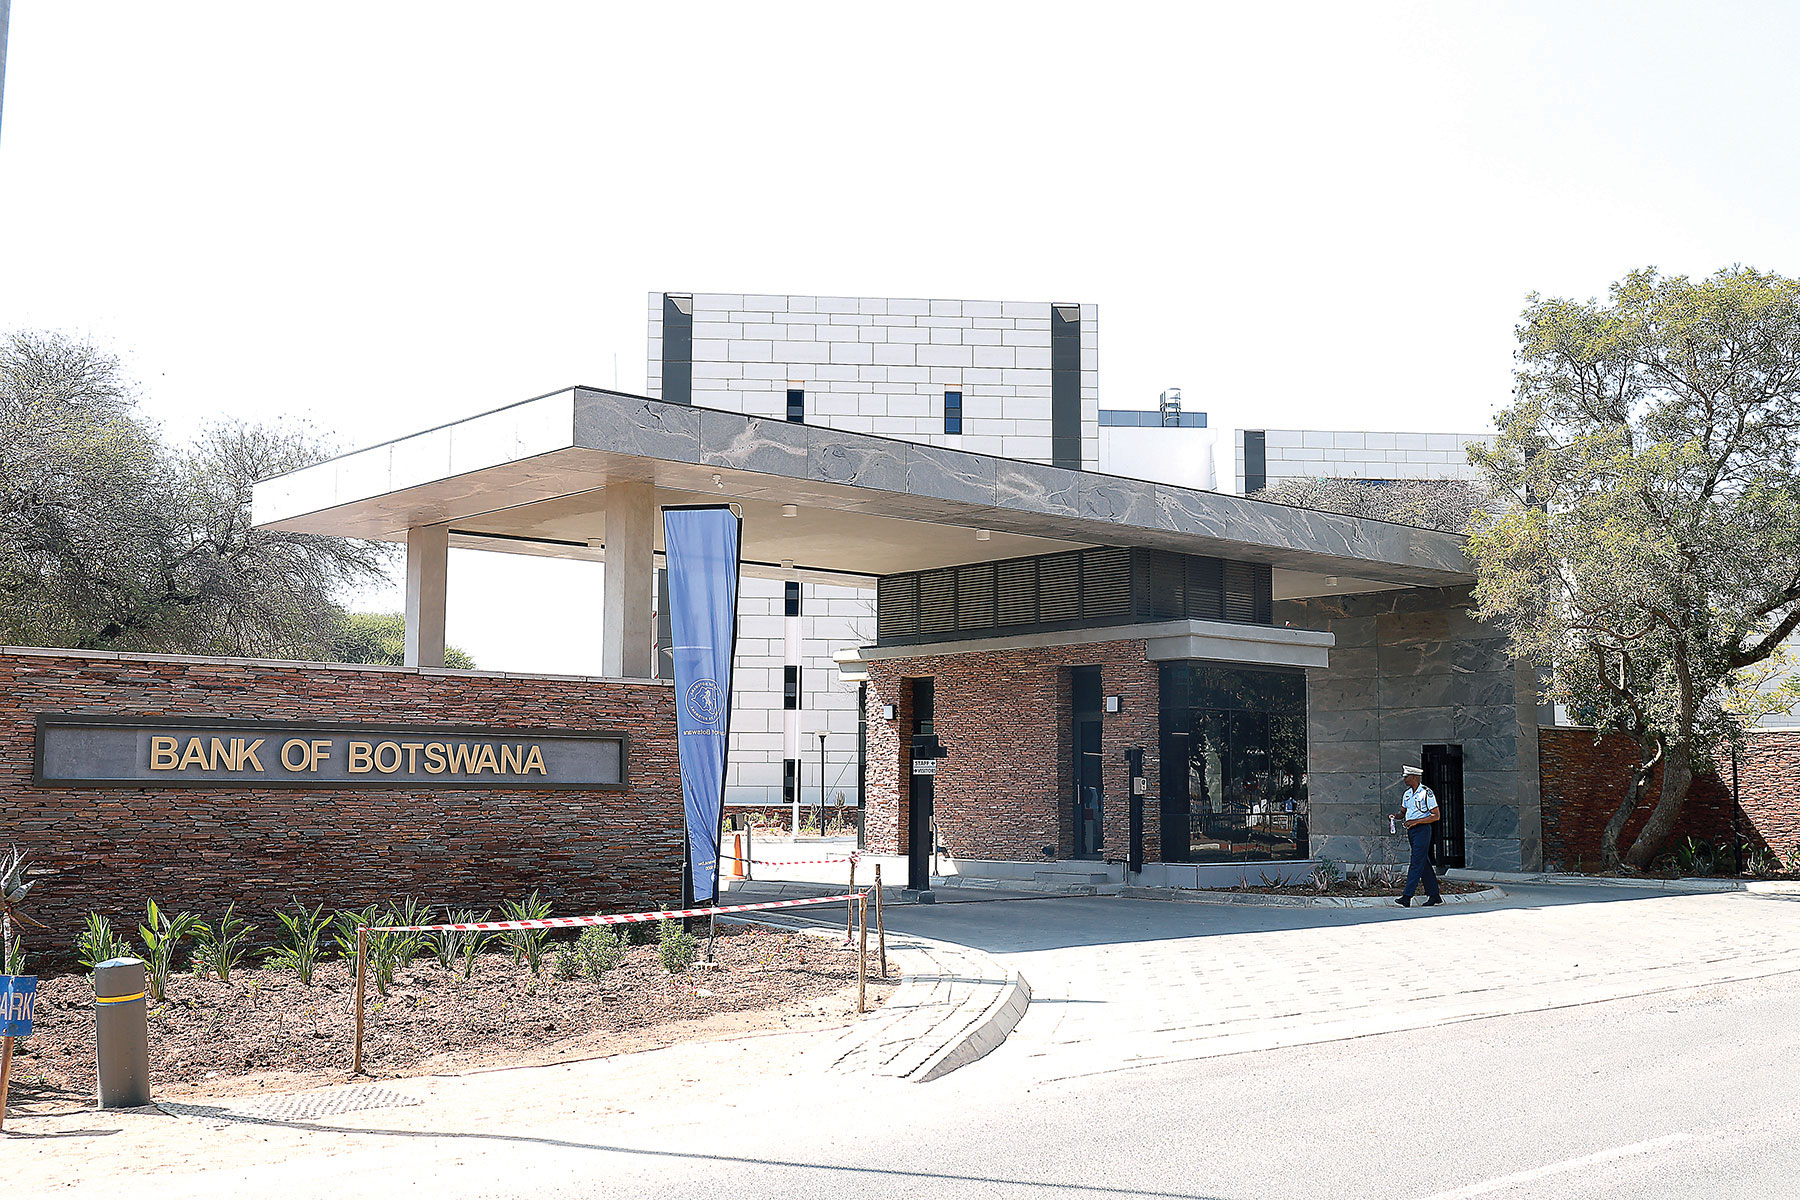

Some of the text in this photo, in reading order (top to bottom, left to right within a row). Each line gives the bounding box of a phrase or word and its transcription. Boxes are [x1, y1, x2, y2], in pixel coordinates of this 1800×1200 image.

[151, 736, 548, 775] BANK OF BOTSWANA
